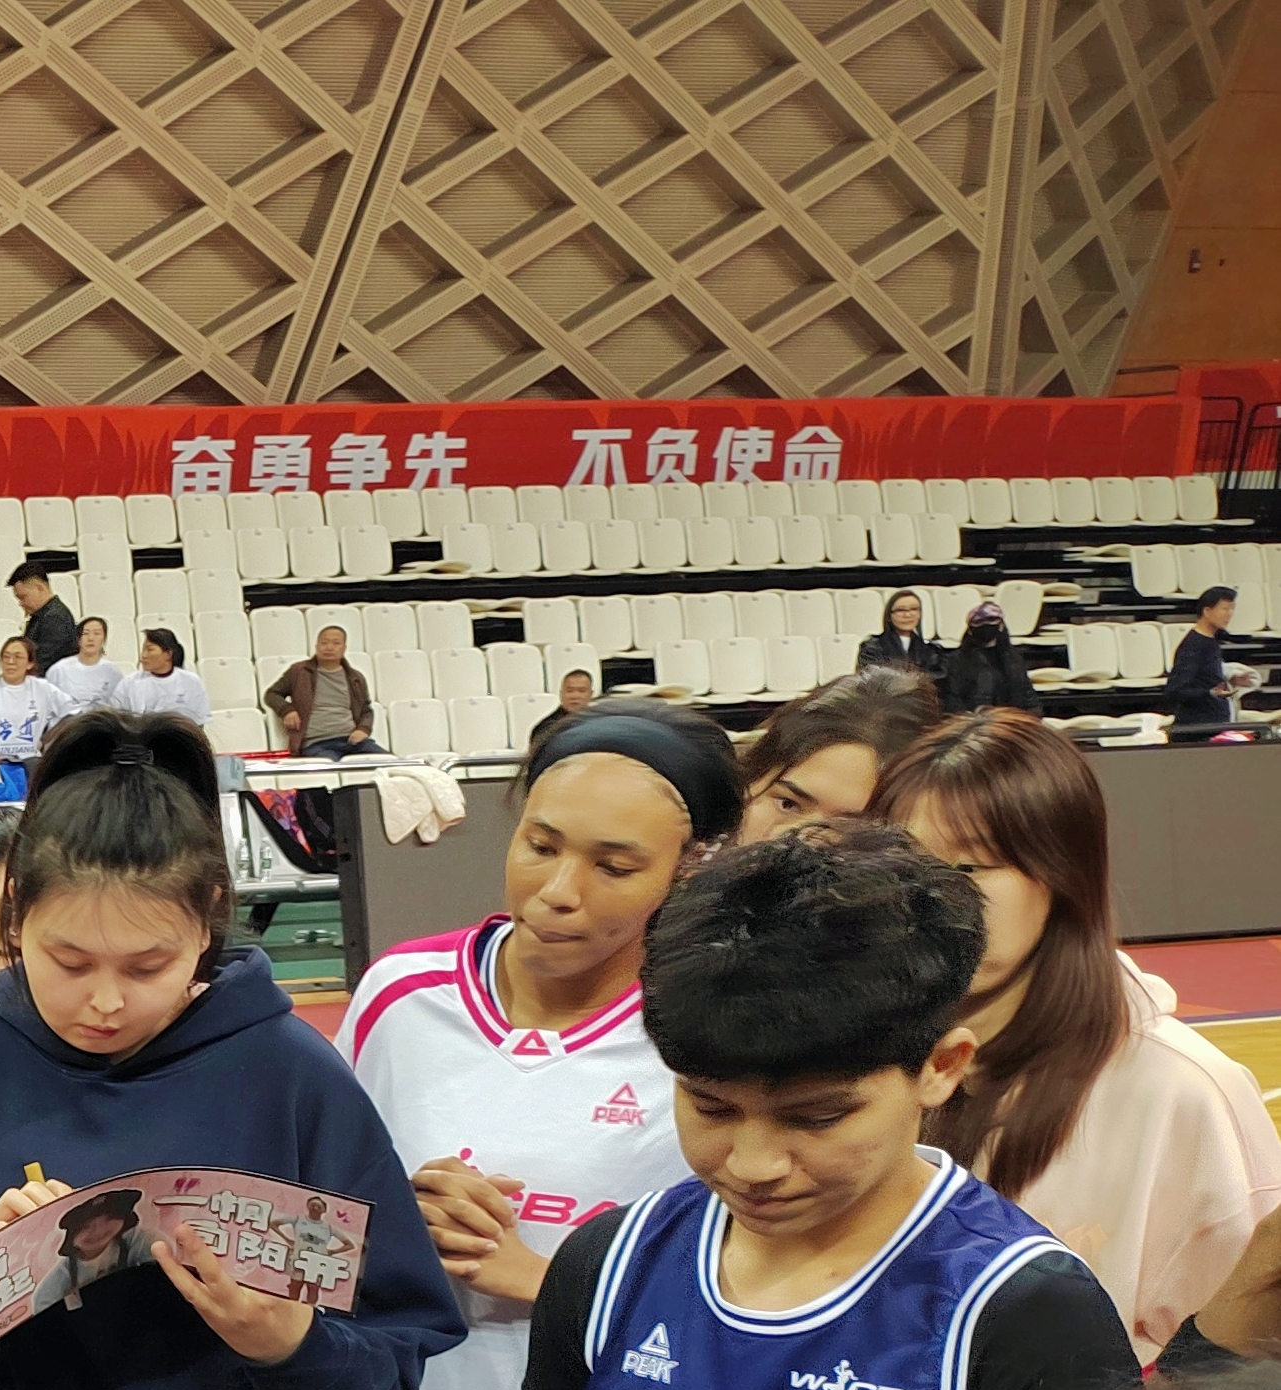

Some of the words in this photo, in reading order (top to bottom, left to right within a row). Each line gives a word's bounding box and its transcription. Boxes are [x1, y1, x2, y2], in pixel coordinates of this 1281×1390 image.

[171, 430, 468, 497] 奋勇争先
[567, 424, 845, 486] 不负使命
[591, 1105, 648, 1127] PEAK
[622, 1353, 681, 1385] PEAK
